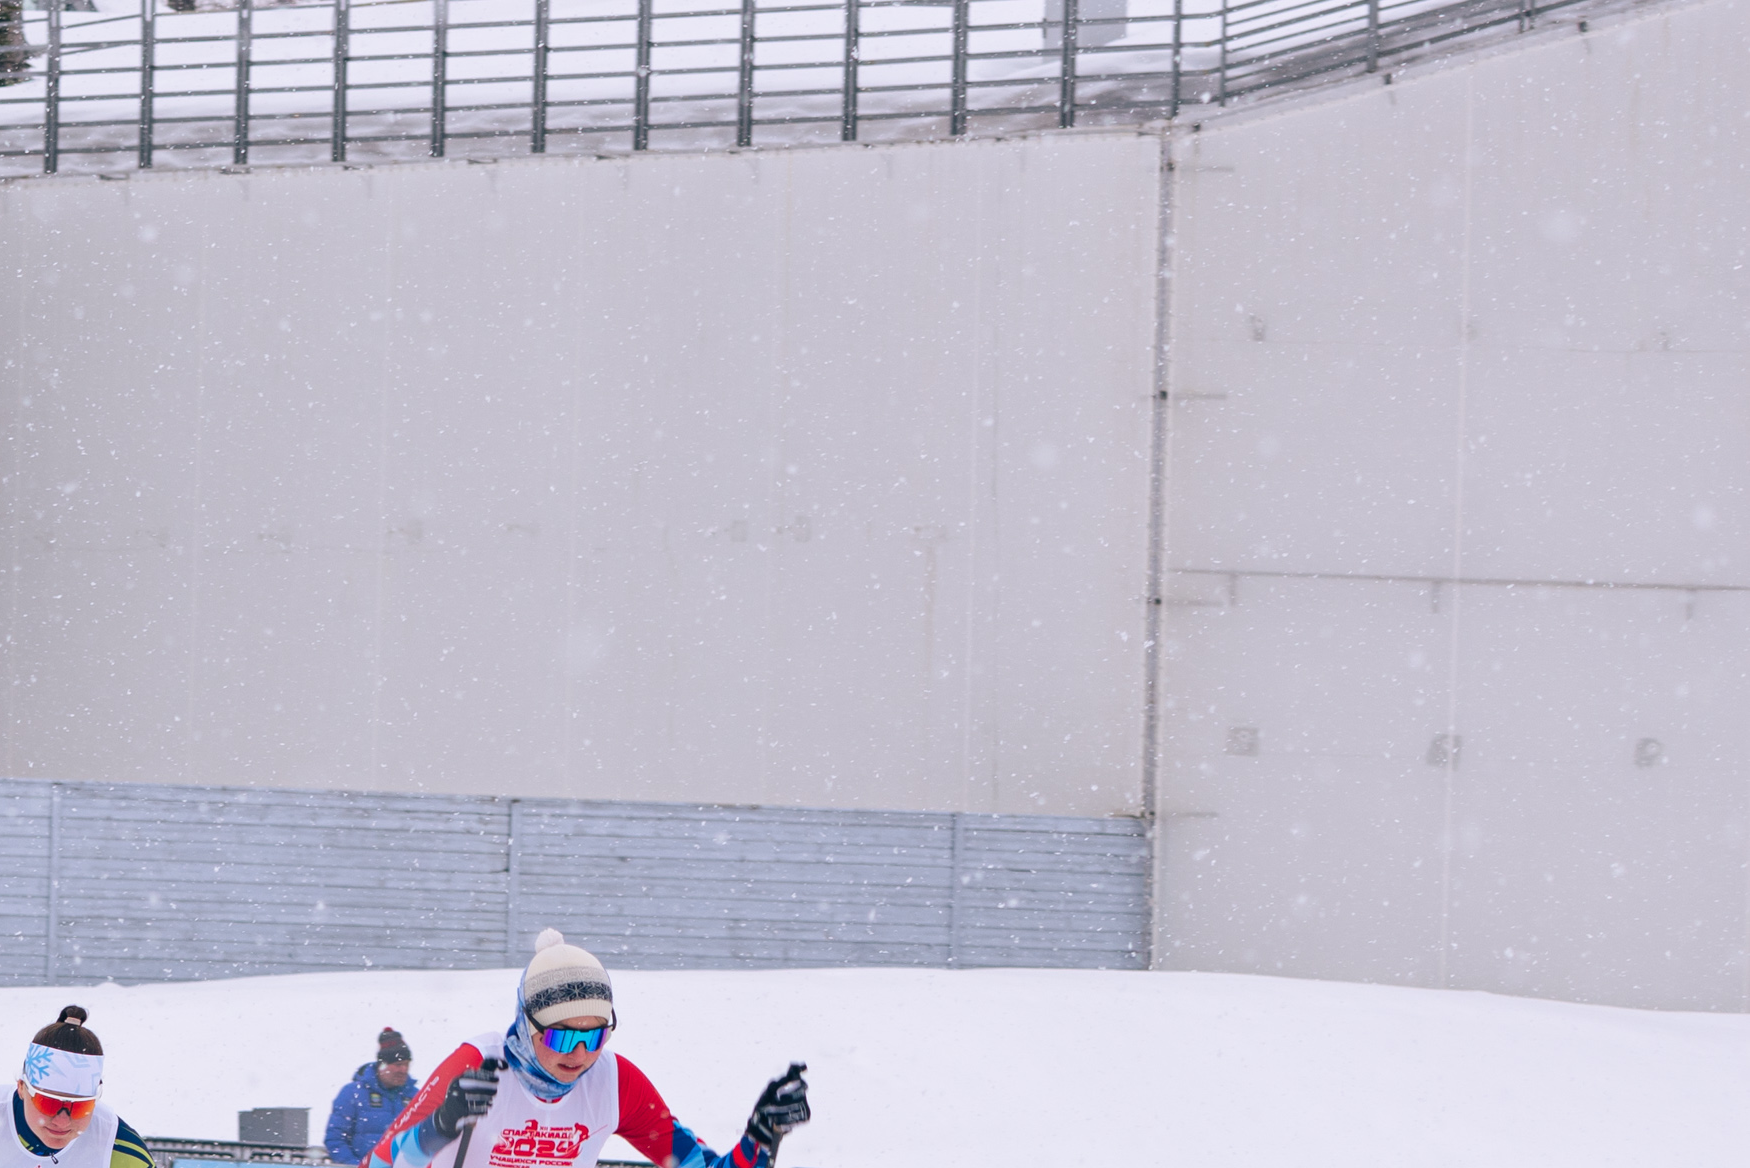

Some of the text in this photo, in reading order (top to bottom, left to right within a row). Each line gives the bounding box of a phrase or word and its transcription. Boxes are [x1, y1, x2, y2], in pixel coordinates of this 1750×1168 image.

[502, 1128, 574, 1140] СПАРТАКИАДА
[492, 1136, 583, 1160] 2024
[490, 1154, 573, 1167] УЧАЩИХСЯ РОССИИ
